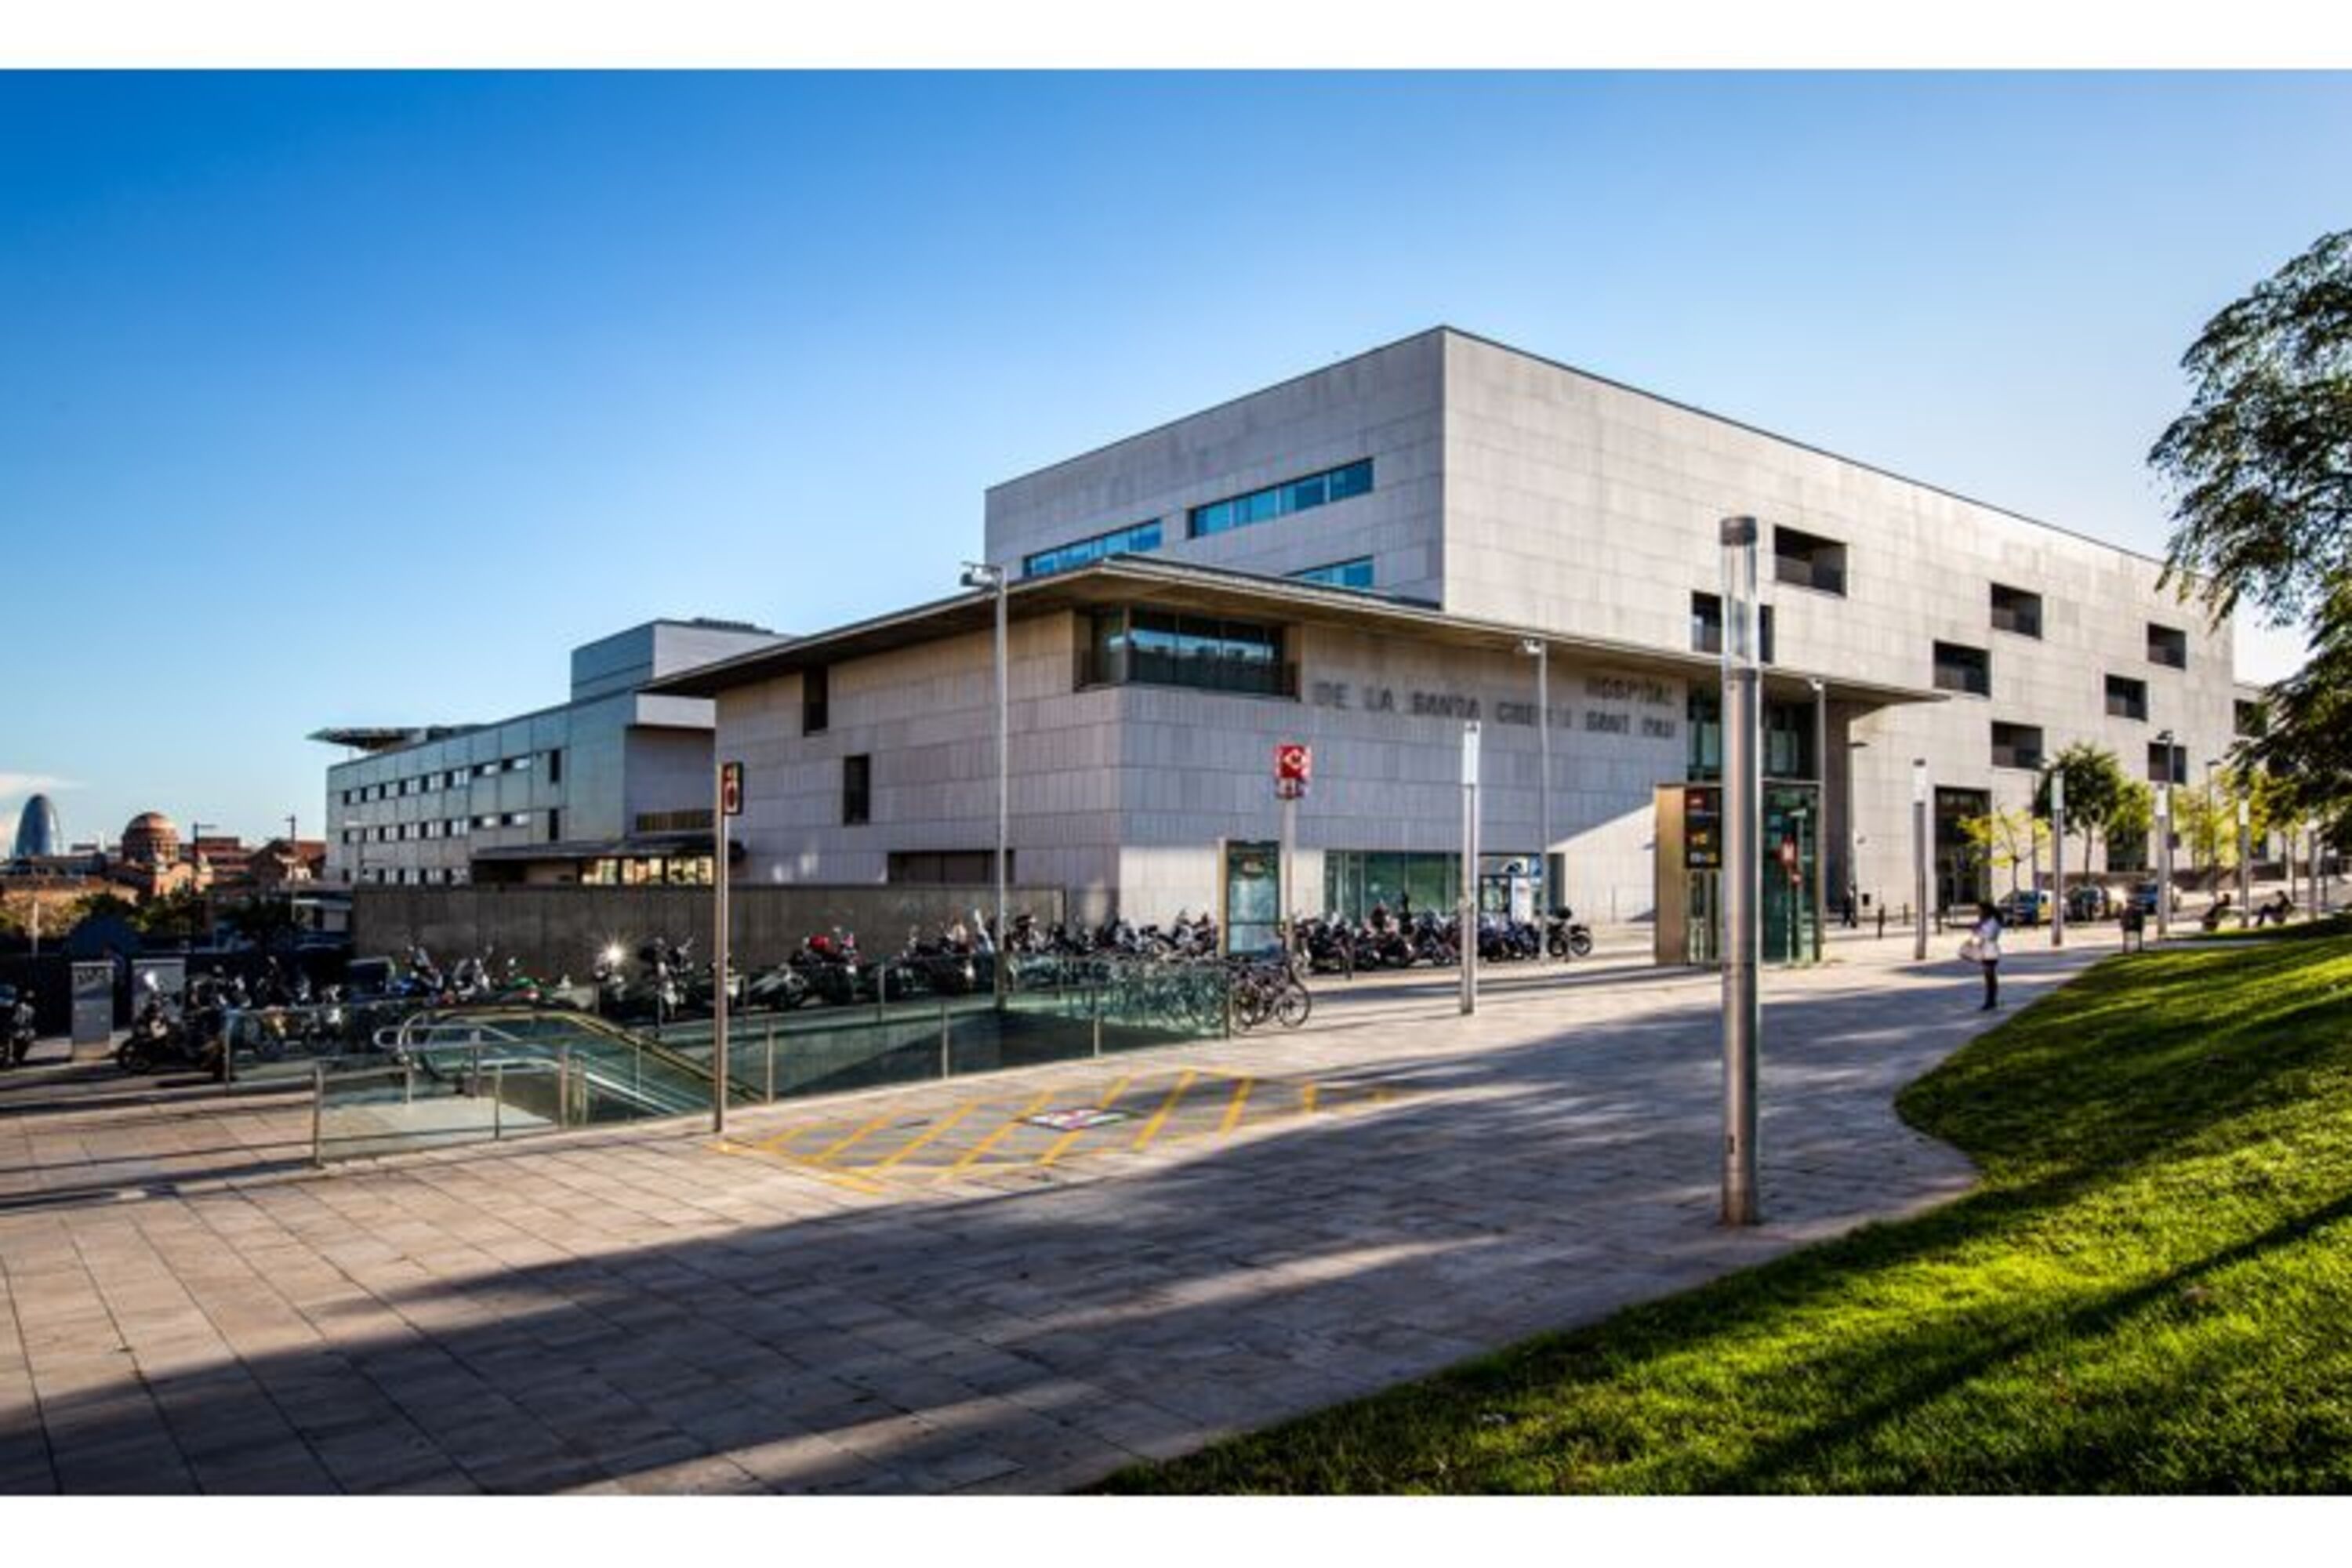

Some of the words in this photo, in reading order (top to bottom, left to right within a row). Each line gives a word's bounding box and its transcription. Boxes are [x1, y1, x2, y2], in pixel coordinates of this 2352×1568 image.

[1313, 681, 1349, 710] DE
[1363, 685, 1394, 713] LA
[1412, 691, 1481, 719] SANTA
[1585, 711, 1629, 735] SANT
[1642, 717, 1675, 739] PAU
